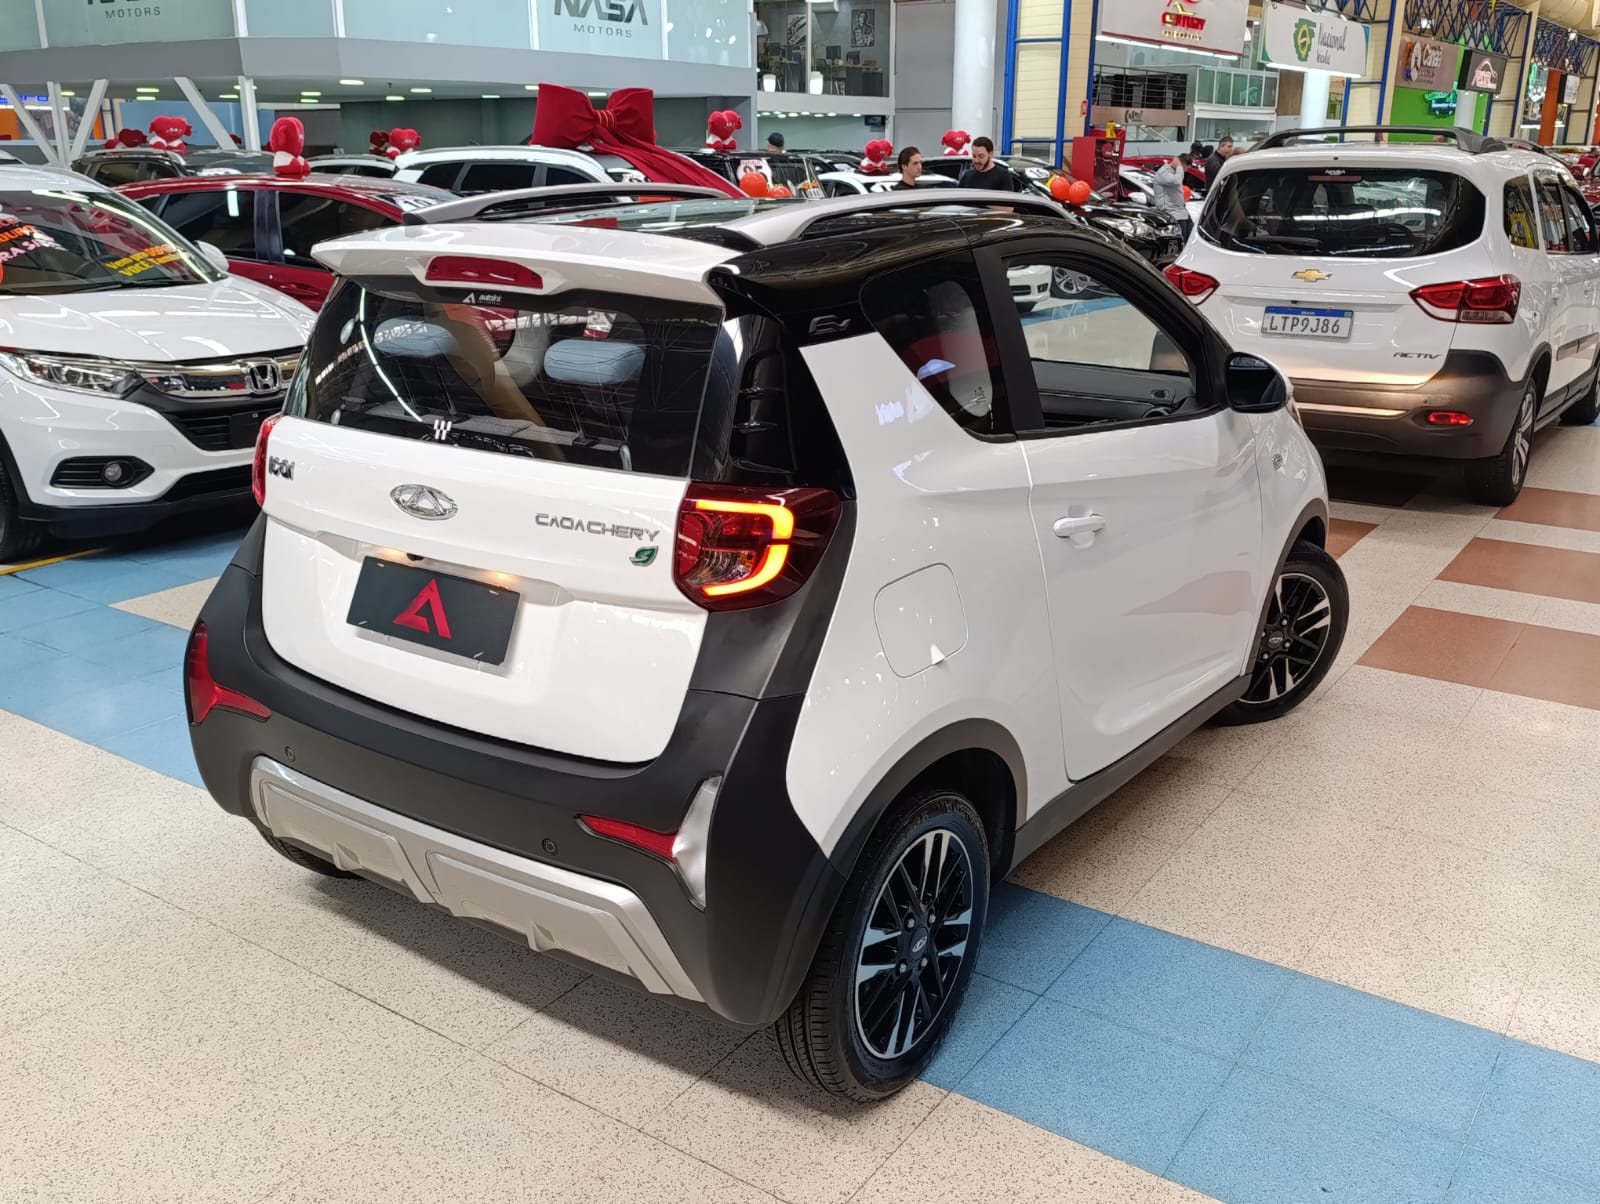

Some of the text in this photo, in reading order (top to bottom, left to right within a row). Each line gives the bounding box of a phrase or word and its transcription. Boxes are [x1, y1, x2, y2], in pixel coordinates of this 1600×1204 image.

[105, 6, 161, 19] MOTORS
[553, 0, 649, 26] NASA
[573, 23, 633, 39] MOTORS
[1269, 315, 1340, 334] LTP9J86
